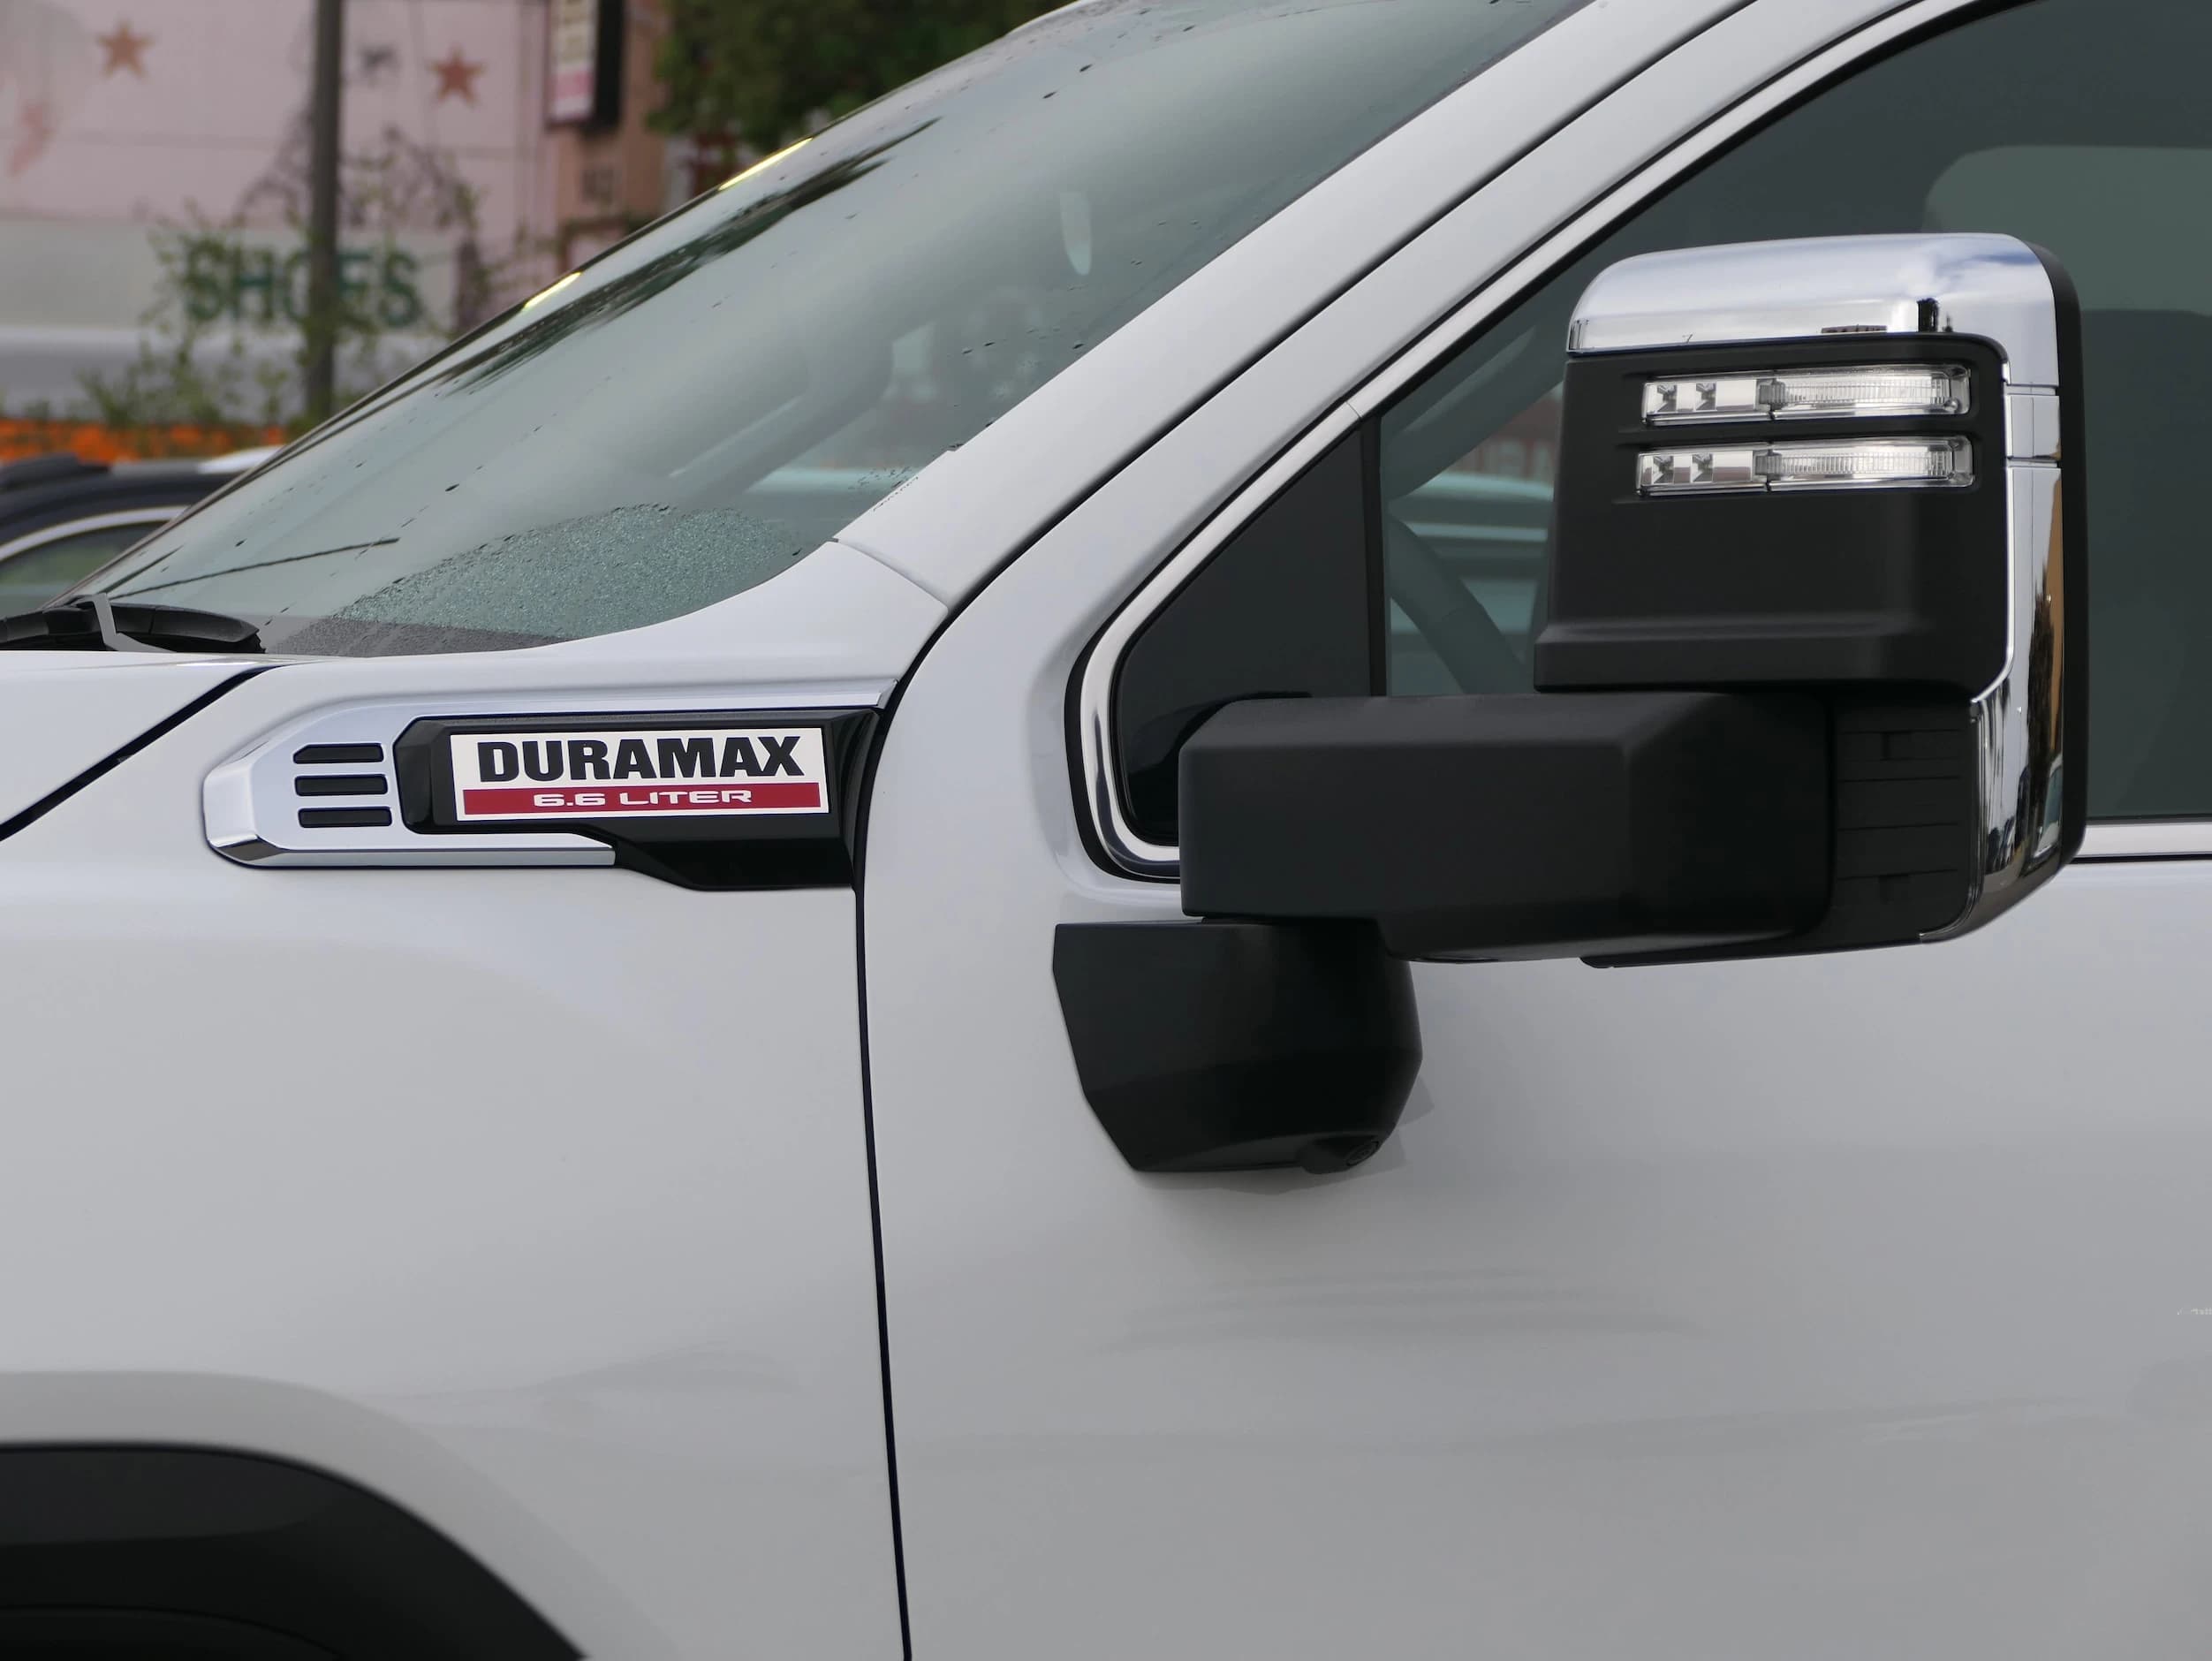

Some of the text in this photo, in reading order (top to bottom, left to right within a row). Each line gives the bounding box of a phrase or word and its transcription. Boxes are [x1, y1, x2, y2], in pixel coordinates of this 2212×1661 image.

[477, 736, 805, 783] DURAMAX
[534, 790, 752, 808] 6.6 LITER
